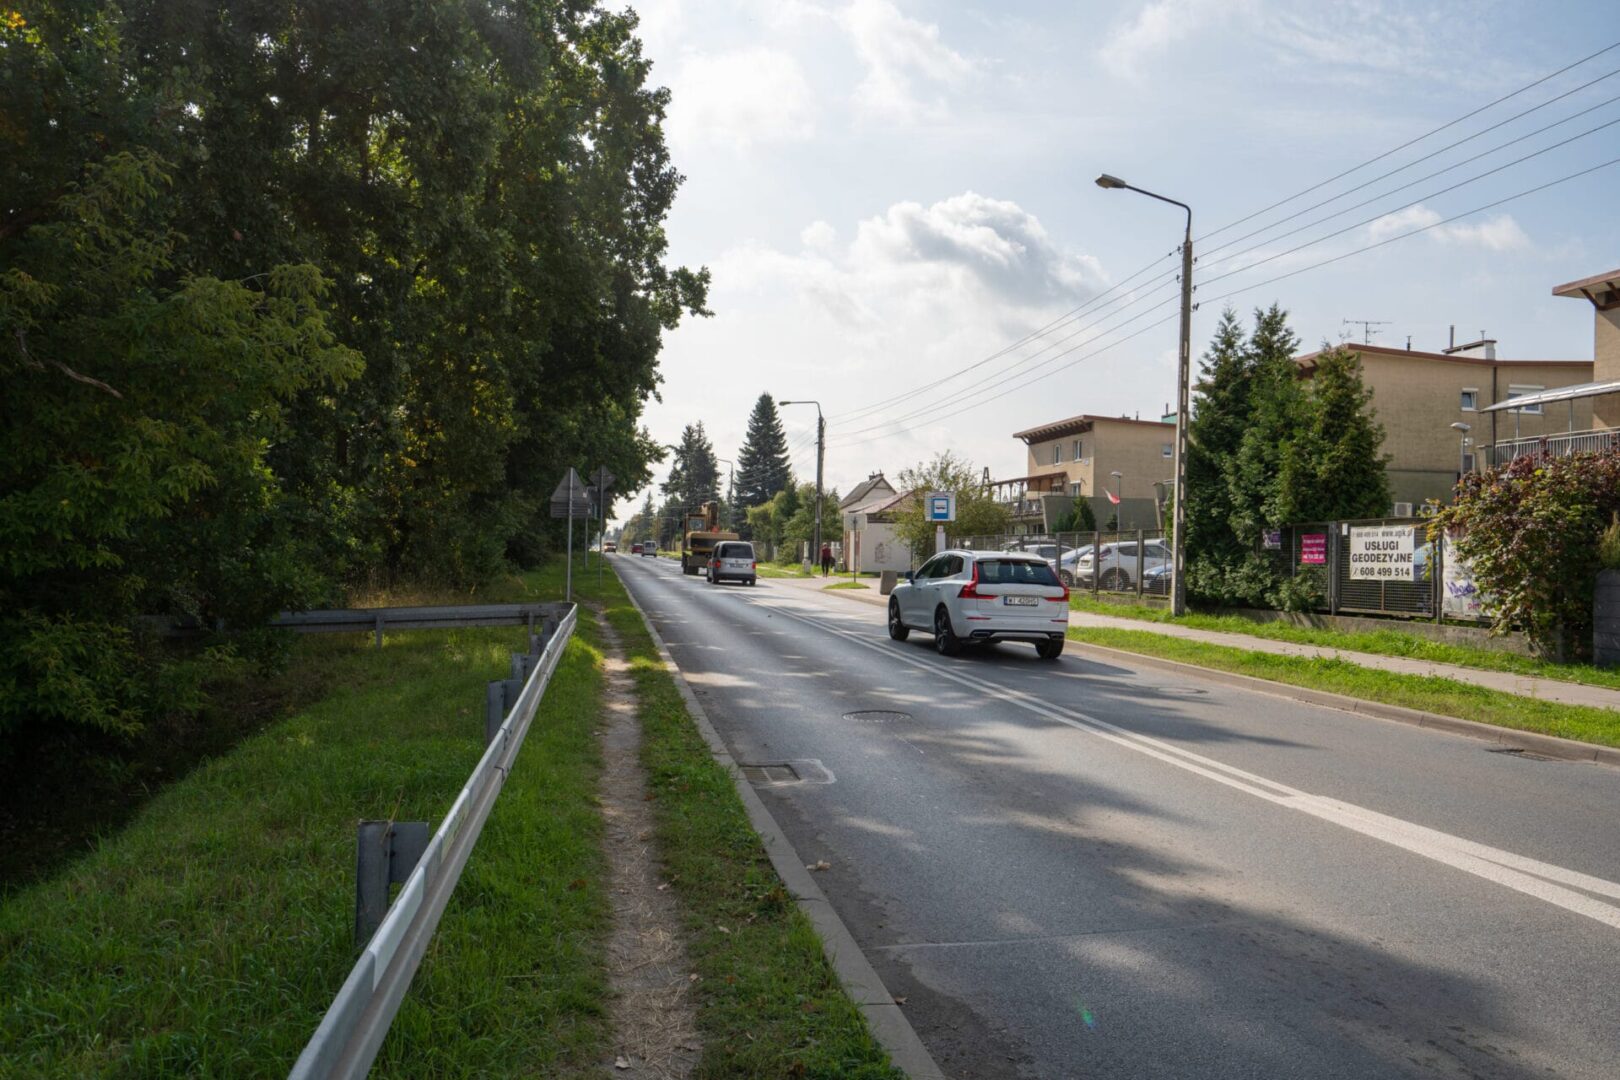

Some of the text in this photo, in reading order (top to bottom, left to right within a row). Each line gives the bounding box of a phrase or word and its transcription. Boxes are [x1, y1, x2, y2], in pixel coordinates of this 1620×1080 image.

[1364, 541, 1399, 551] USŁUGI
[1351, 553, 1413, 563] GEODEZYJNE
[1360, 567, 1410, 577] 608 499 514
